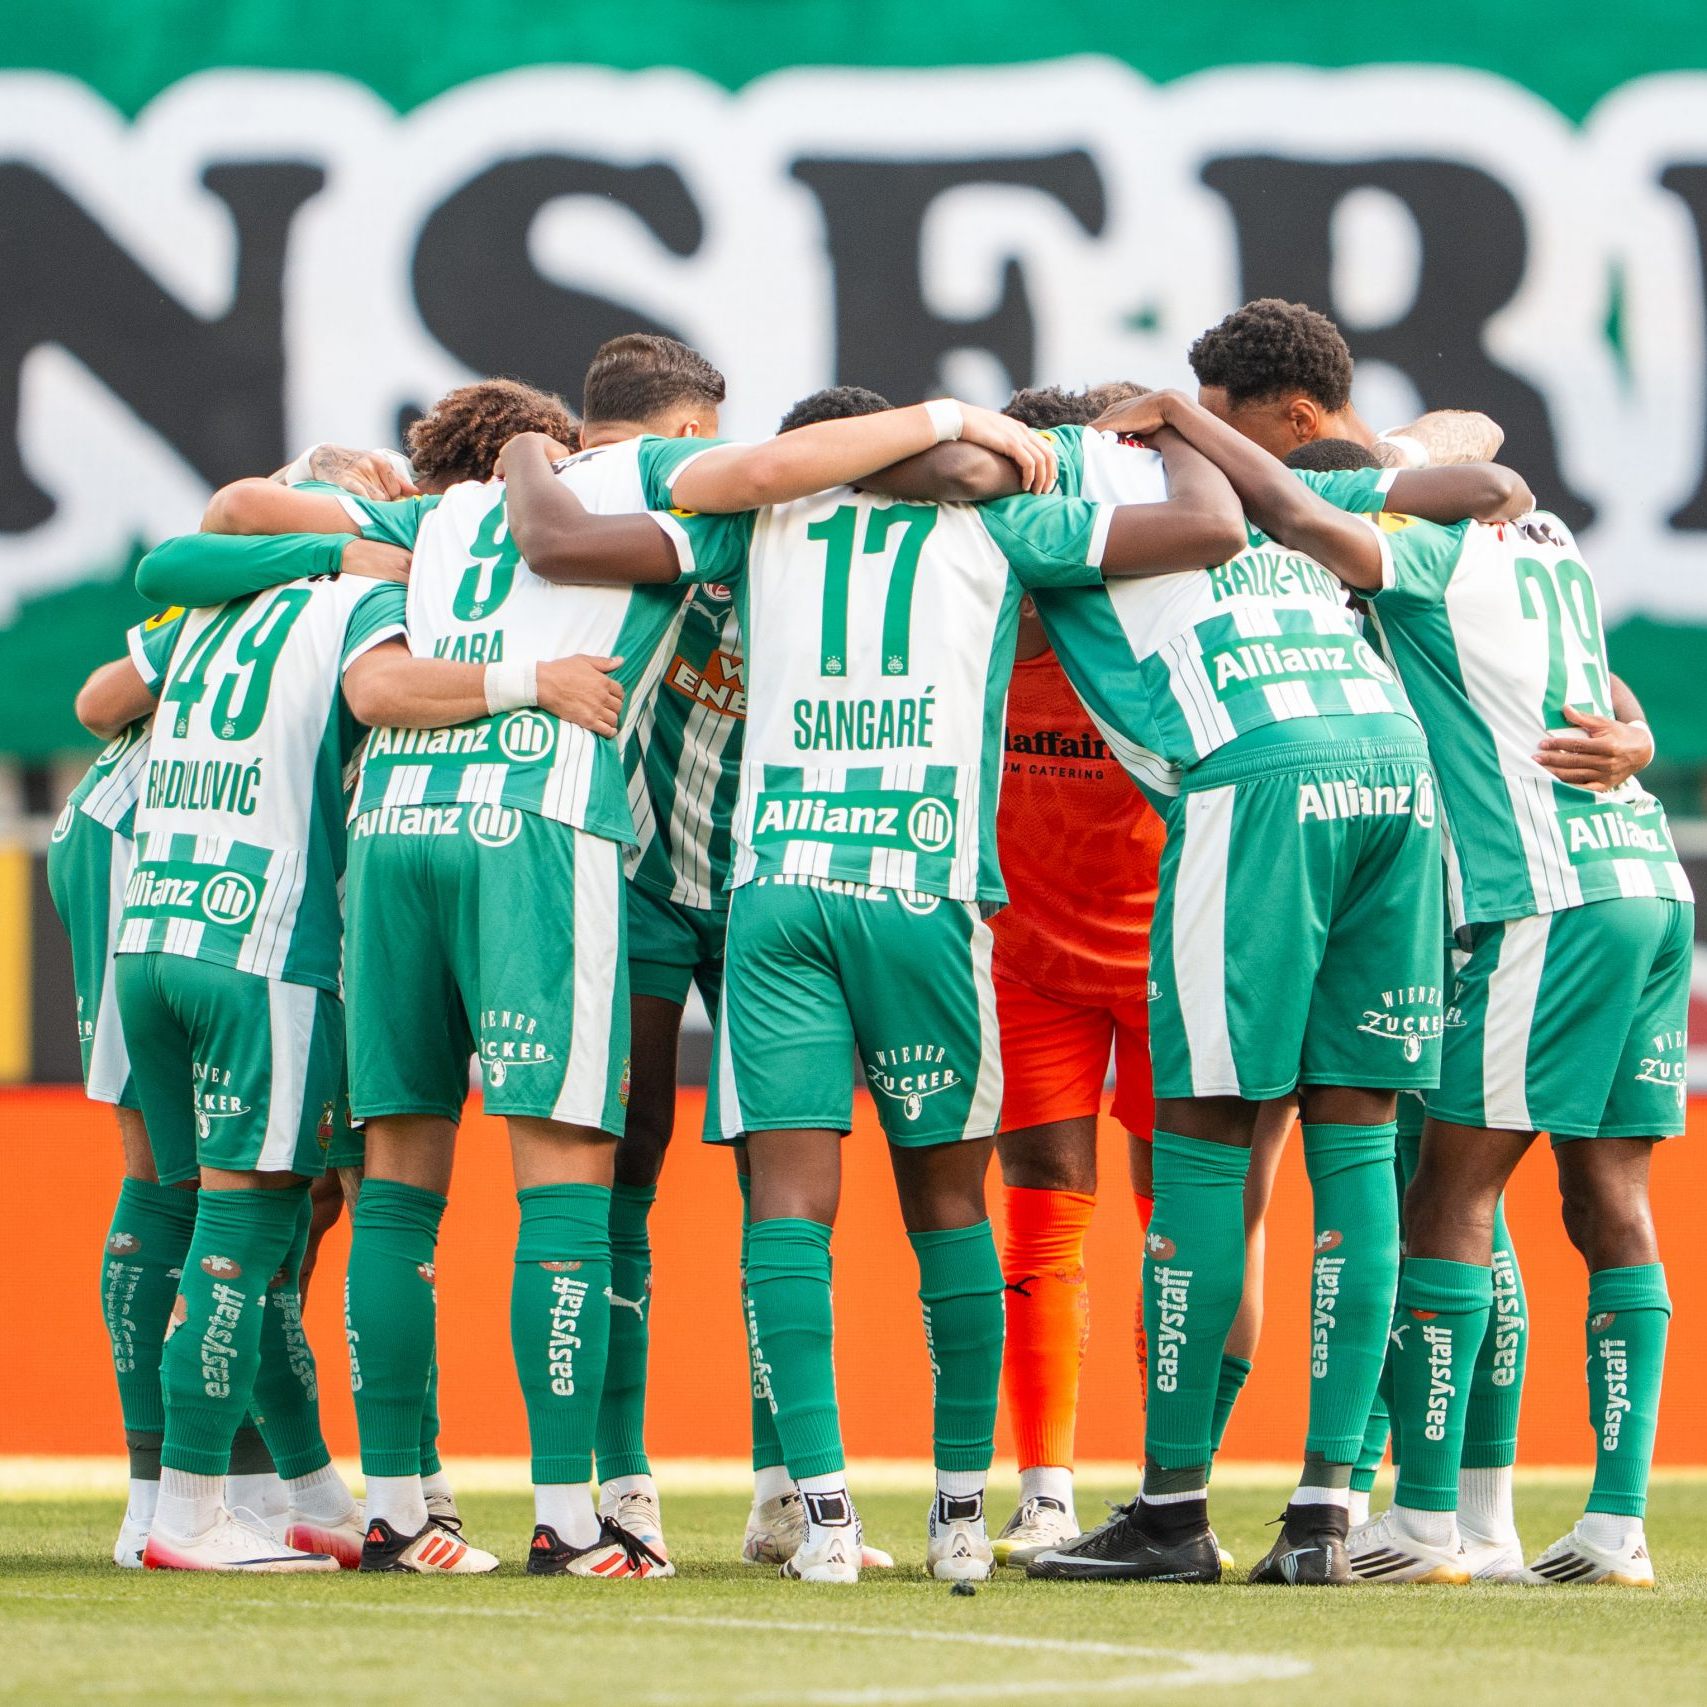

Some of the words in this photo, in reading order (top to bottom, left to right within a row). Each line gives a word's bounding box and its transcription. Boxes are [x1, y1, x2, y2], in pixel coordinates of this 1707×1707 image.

[0, 150, 1707, 535] NSER
[453, 488, 522, 622] 9
[807, 504, 939, 677] 17
[163, 588, 314, 741] 49
[1213, 642, 1352, 691] Allianz
[1514, 557, 1615, 731] 29
[369, 723, 492, 760] Allianz
[794, 685, 935, 752] SANGARÉ
[1029, 764, 1104, 779] CATERING
[353, 805, 463, 841] Allianz
[756, 798, 900, 836] Allianz
[1298, 779, 1413, 824] Allianz
[868, 1064, 957, 1095] ZUCKER
[875, 1044, 946, 1067] WIENER
[1358, 1010, 1443, 1037] ZUCKE
[201, 1282, 247, 1399] easystaff
[549, 1276, 590, 1397] easystaff
[1154, 1265, 1194, 1393] easystaff
[1312, 1256, 1346, 1379] easystaff
[1424, 1325, 1456, 1442] easystaff
[1603, 1338, 1632, 1453] easystaff
